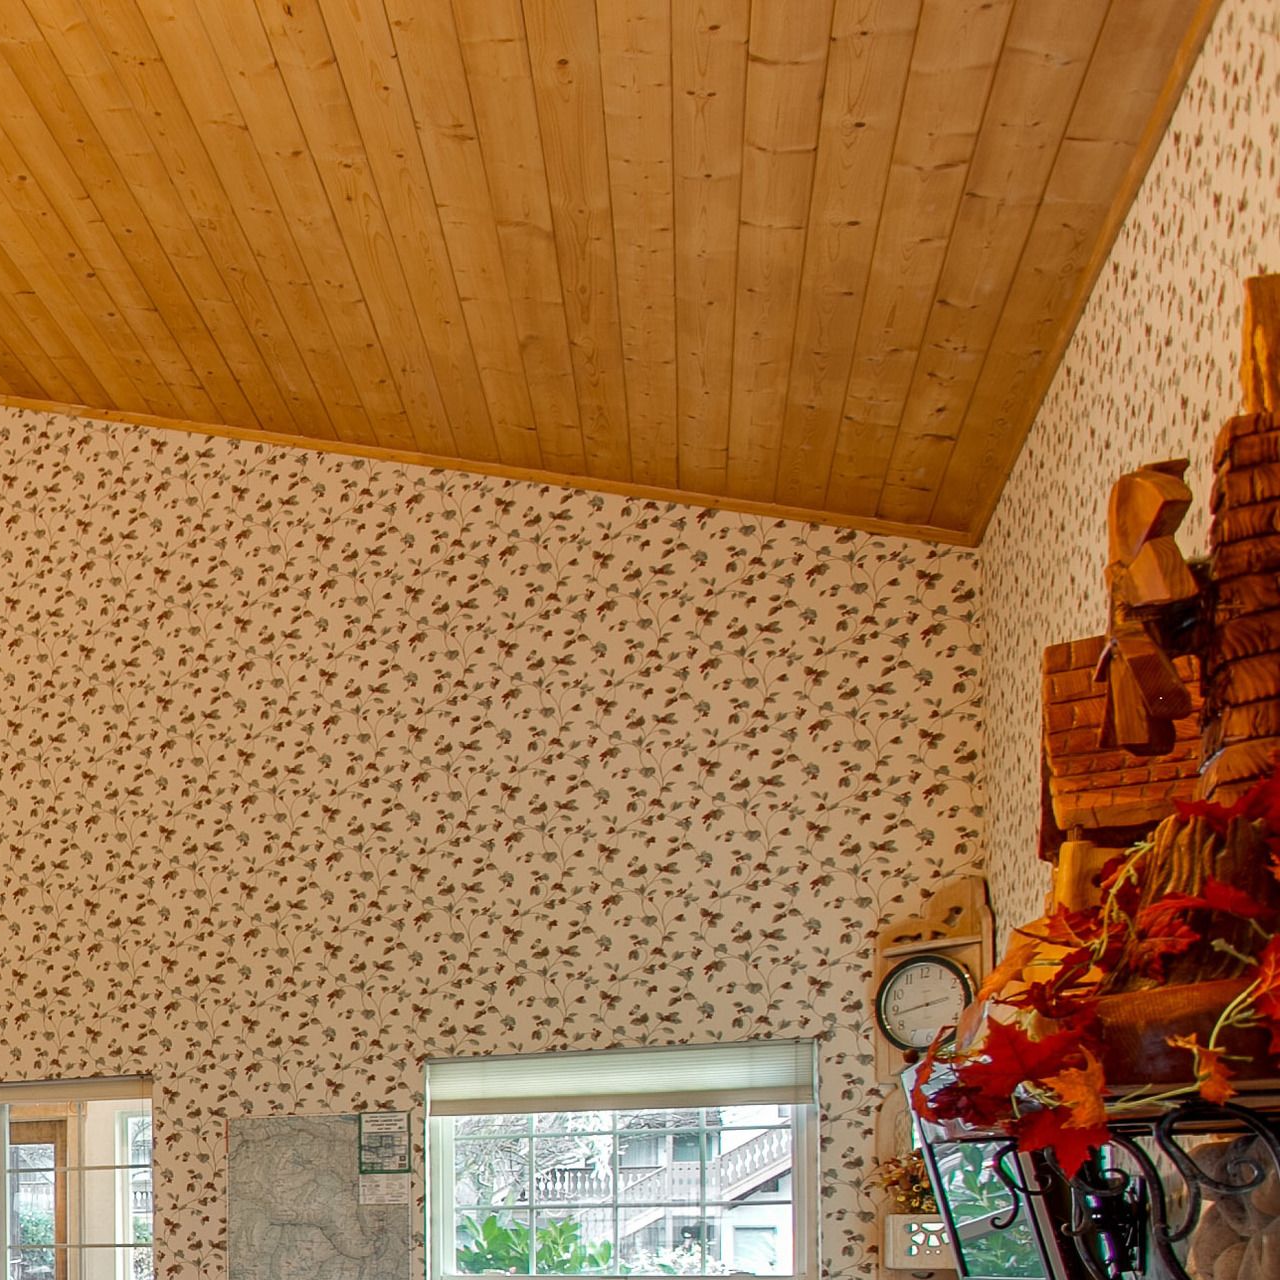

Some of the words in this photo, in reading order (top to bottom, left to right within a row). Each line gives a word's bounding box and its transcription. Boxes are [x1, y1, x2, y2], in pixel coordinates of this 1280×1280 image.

[920, 967, 930, 979] 12
[905, 974, 913, 985] 11
[950, 978, 957, 989] 2
[893, 989, 904, 1001] 10
[892, 1004, 899, 1016] 9
[898, 1020, 905, 1030] 8
[910, 1029, 917, 1041] 7
[926, 1031, 933, 1042] 6
